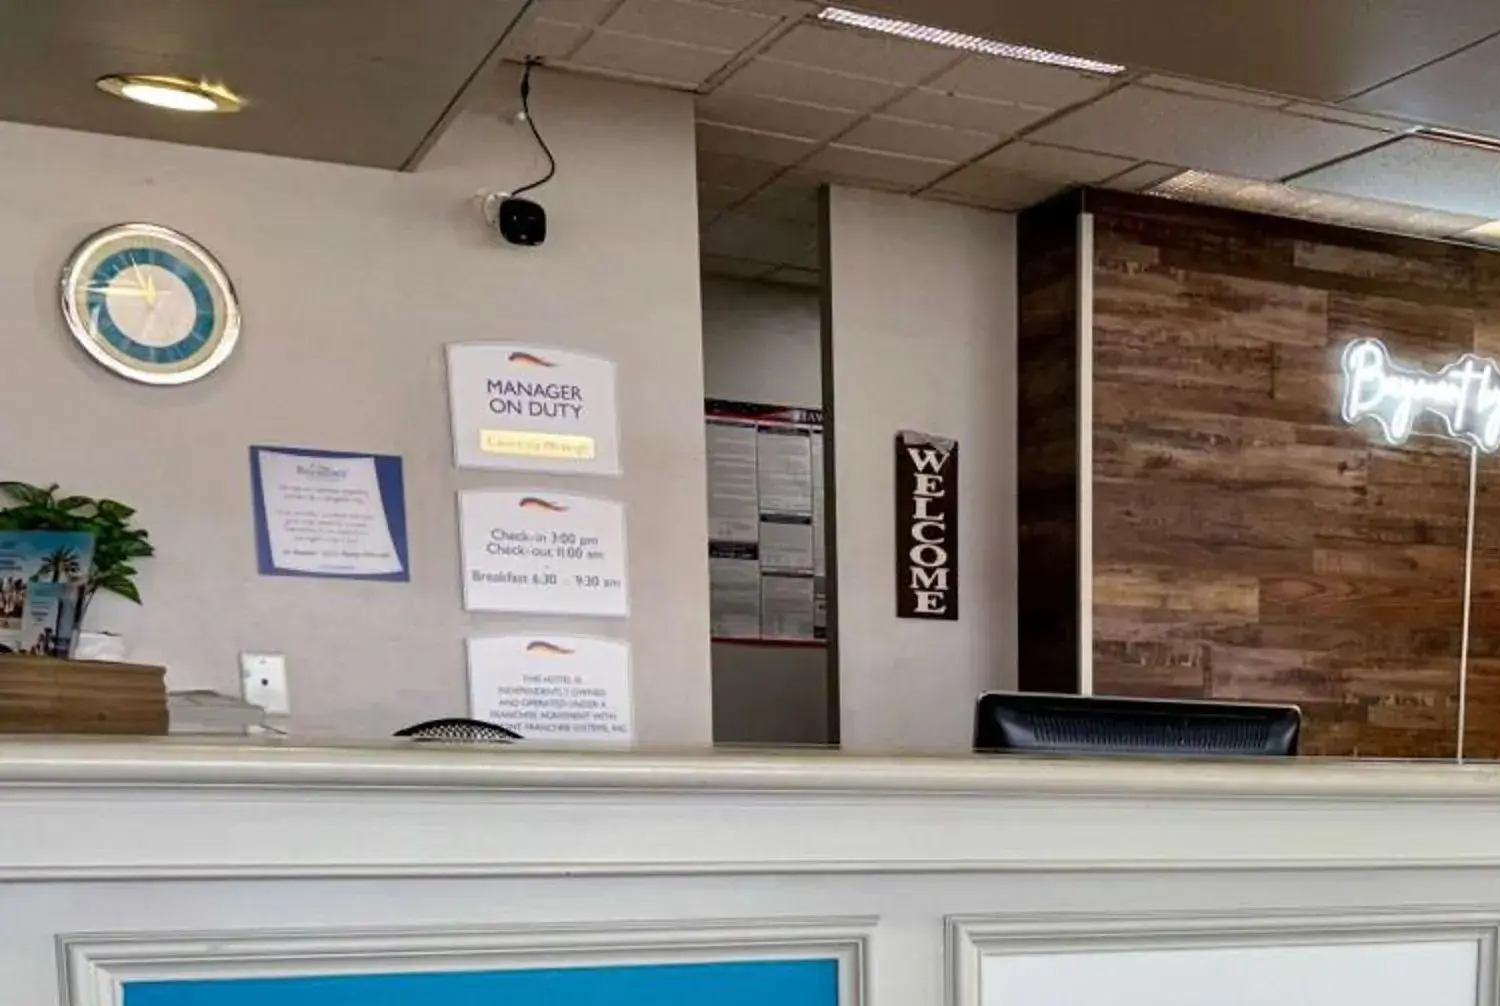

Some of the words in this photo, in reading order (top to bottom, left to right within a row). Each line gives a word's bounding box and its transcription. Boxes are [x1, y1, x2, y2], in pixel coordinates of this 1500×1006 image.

[487, 378, 583, 401] MANAGER
[489, 398, 522, 415] ON
[529, 401, 583, 419] DUTY
[490, 528, 547, 543] Check-in
[551, 531, 577, 545] 3:00
[580, 535, 599, 546] pm
[907, 447, 951, 614] WELCOME
[486, 542, 554, 558] Check-out
[471, 570, 528, 585] Breakfast
